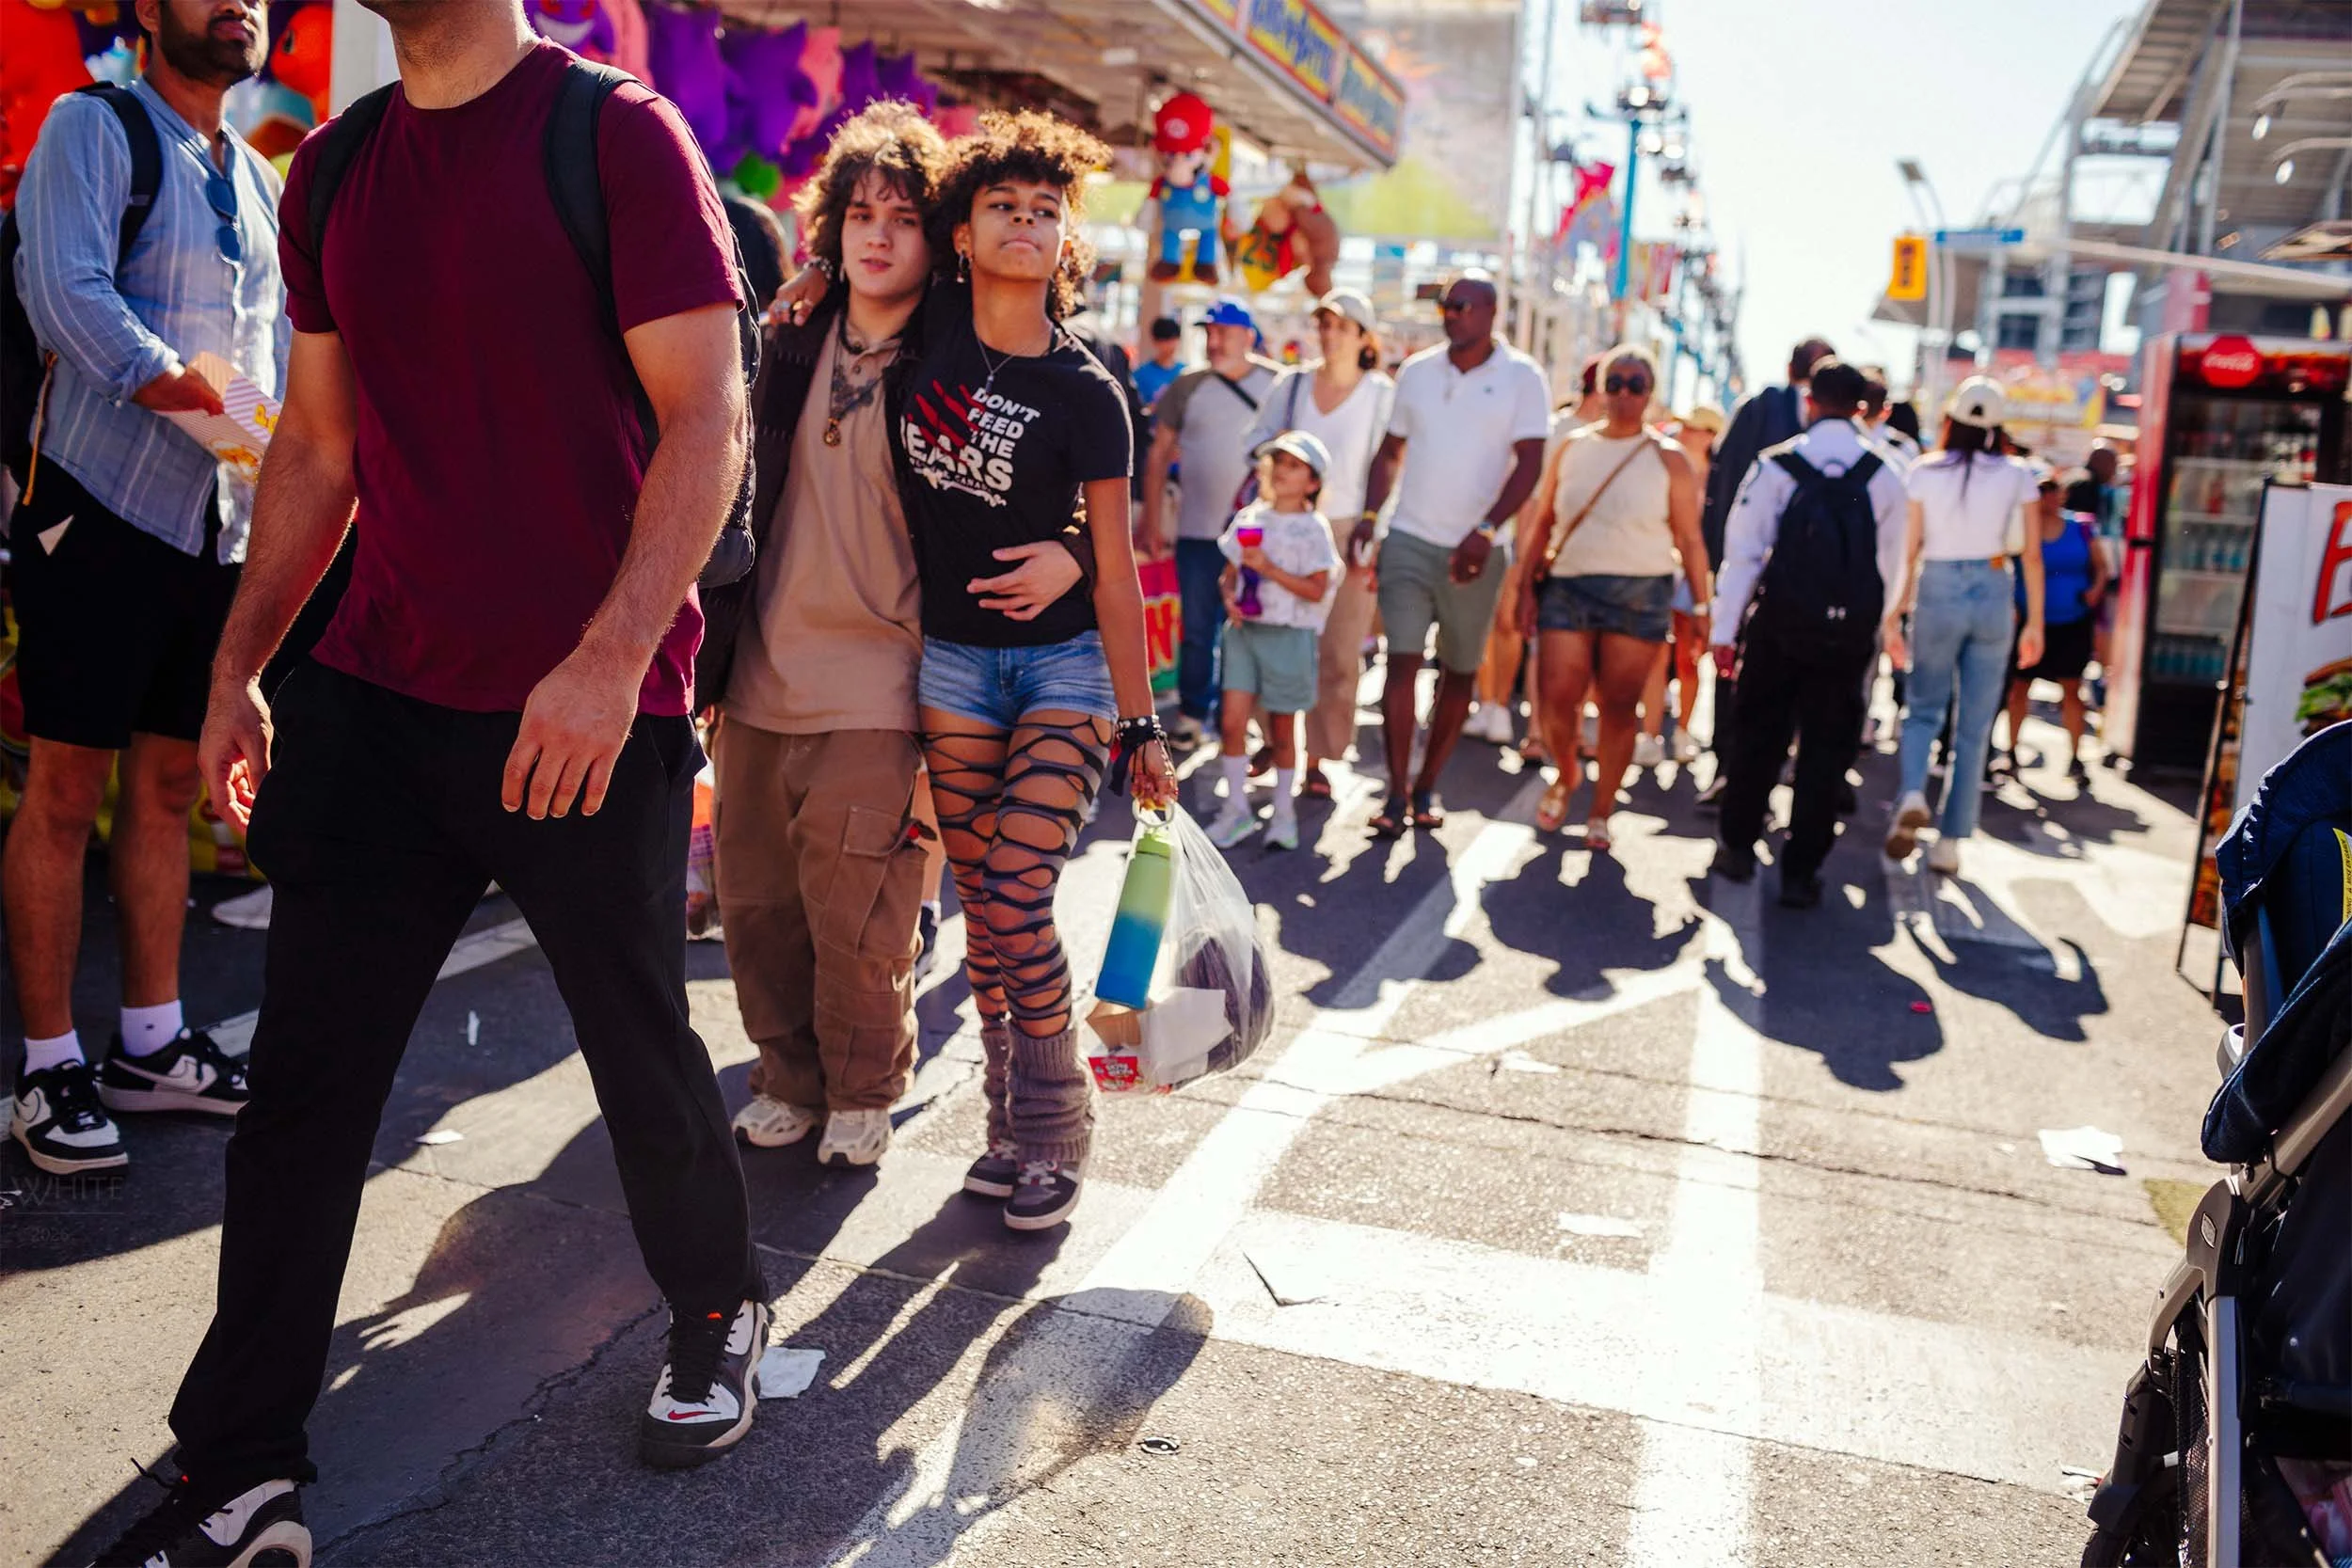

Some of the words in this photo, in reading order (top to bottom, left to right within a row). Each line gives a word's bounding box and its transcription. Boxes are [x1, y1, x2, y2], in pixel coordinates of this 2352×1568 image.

[971, 387, 1041, 423] DON'T
[966, 407, 1025, 440] FEED
[899, 415, 1014, 492] EARS
[970, 429, 1016, 460] THE
